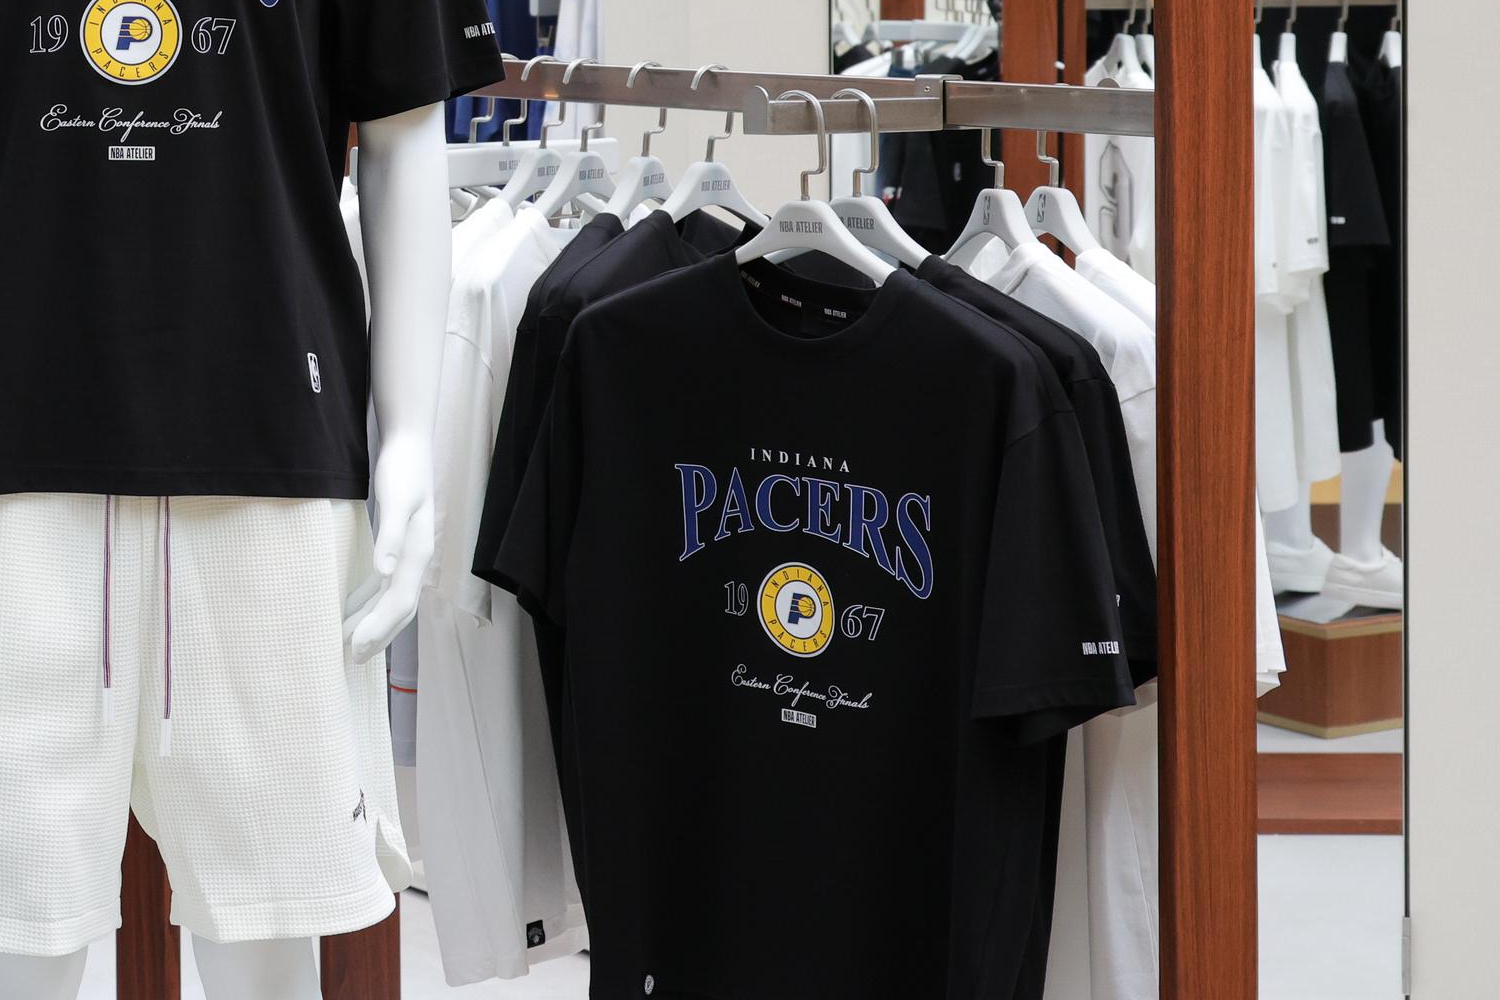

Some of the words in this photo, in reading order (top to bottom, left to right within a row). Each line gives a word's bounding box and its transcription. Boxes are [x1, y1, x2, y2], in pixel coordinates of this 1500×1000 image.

[29, 14, 69, 54] 19
[191, 16, 236, 54] 67
[463, 24, 480, 39] NBA
[92, 47, 169, 78] PACERS
[40, 103, 96, 132] Eastern
[98, 107, 170, 143] Conference
[169, 107, 222, 135] Finals
[110, 147, 124, 158] NBA
[126, 147, 153, 158] ATELIER
[779, 220, 794, 233] NBA
[795, 221, 823, 234] ATELIER
[847, 216, 875, 230] ATELIER
[750, 448, 850, 473] INDIANA
[674, 464, 934, 600] PACERS
[765, 569, 829, 607] INDIANA
[724, 580, 749, 617] 19
[840, 604, 885, 641] 67
[768, 618, 827, 651] PACERS
[731, 663, 771, 690] Eastern
[773, 673, 827, 707] Conference
[825, 685, 873, 709] Finals
